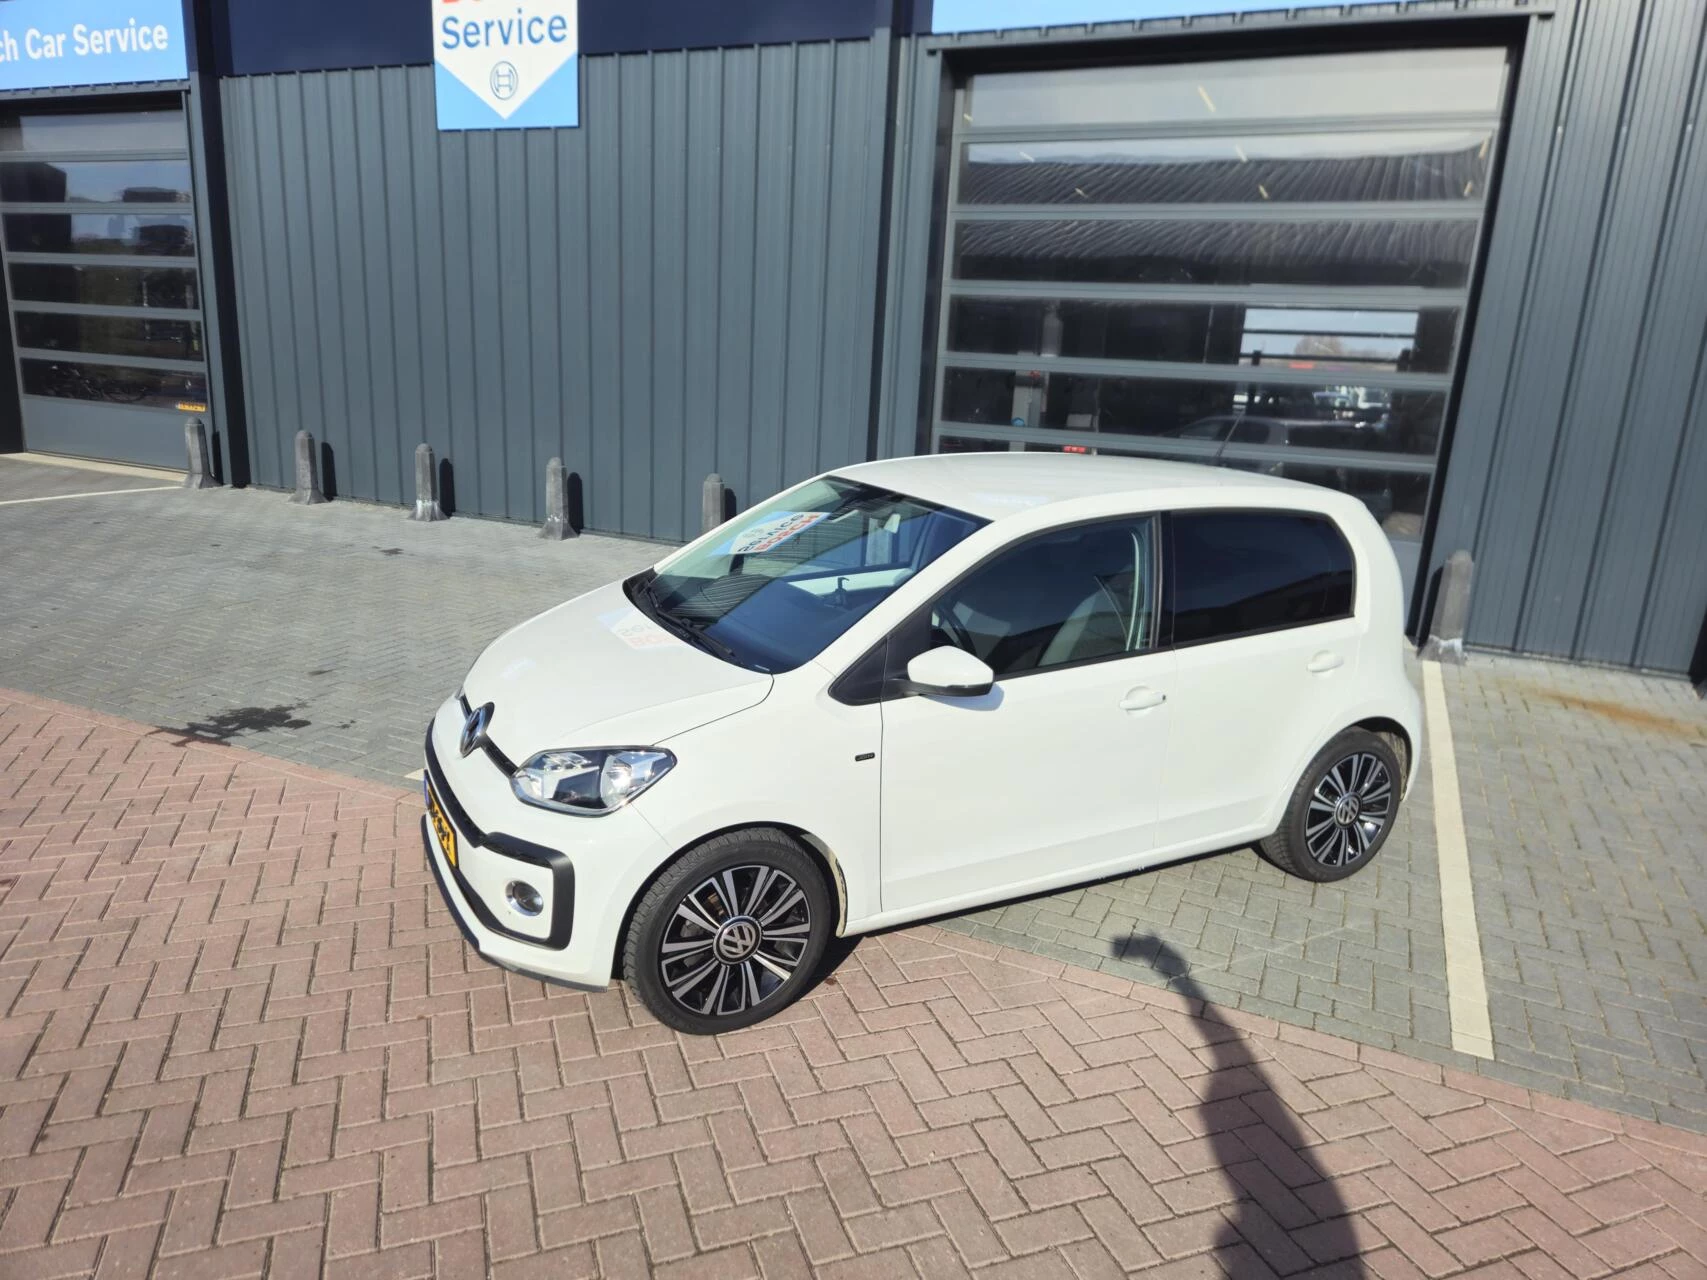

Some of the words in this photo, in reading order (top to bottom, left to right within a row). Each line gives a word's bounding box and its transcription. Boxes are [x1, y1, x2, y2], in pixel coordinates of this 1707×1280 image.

[25, 28, 67, 60] Car
[72, 17, 169, 56] Service
[441, 7, 568, 50] Service
